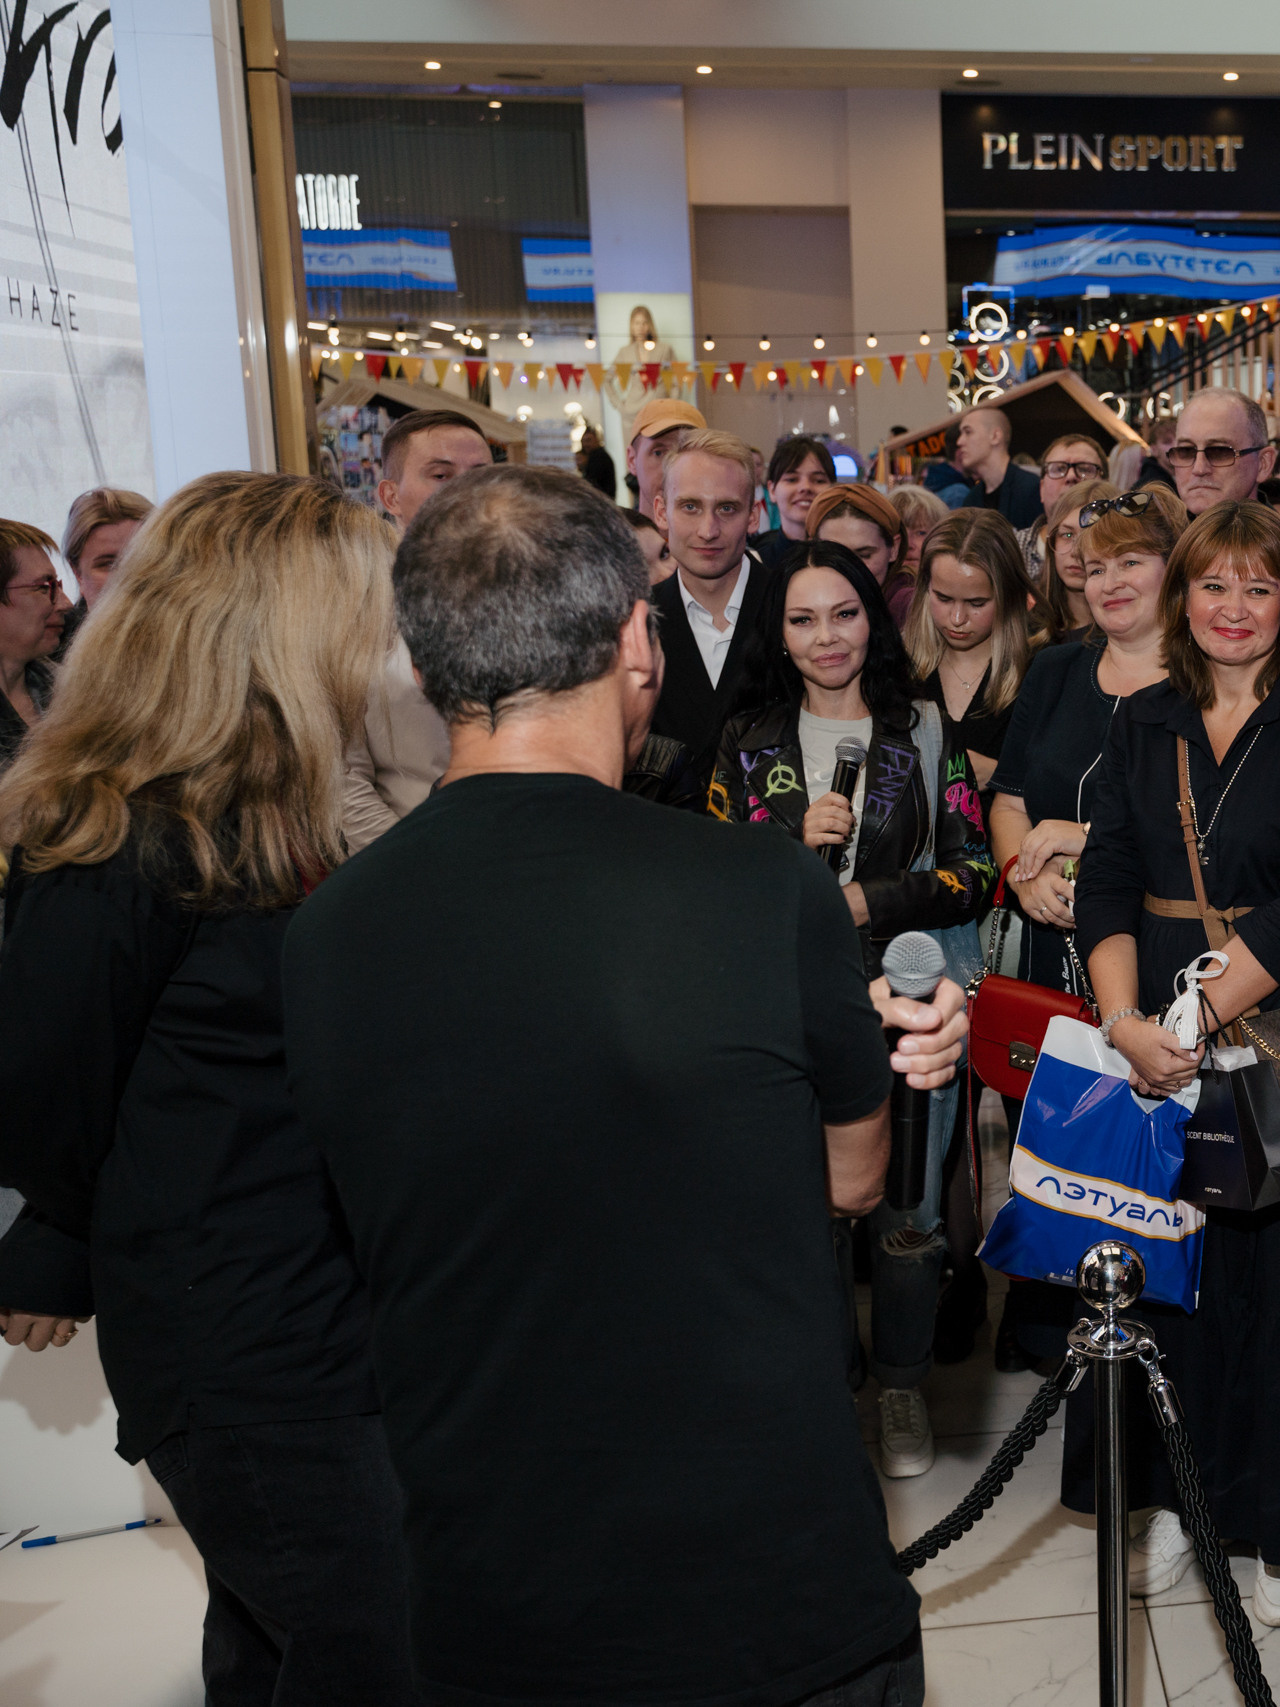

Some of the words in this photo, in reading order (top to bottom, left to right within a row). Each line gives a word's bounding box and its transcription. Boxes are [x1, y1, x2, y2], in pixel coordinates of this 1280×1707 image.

[981, 132, 1105, 171] PLEIN
[1109, 134, 1245, 172] SPORT
[6, 275, 79, 332] HAZE
[1187, 1131, 1202, 1140] SCENT
